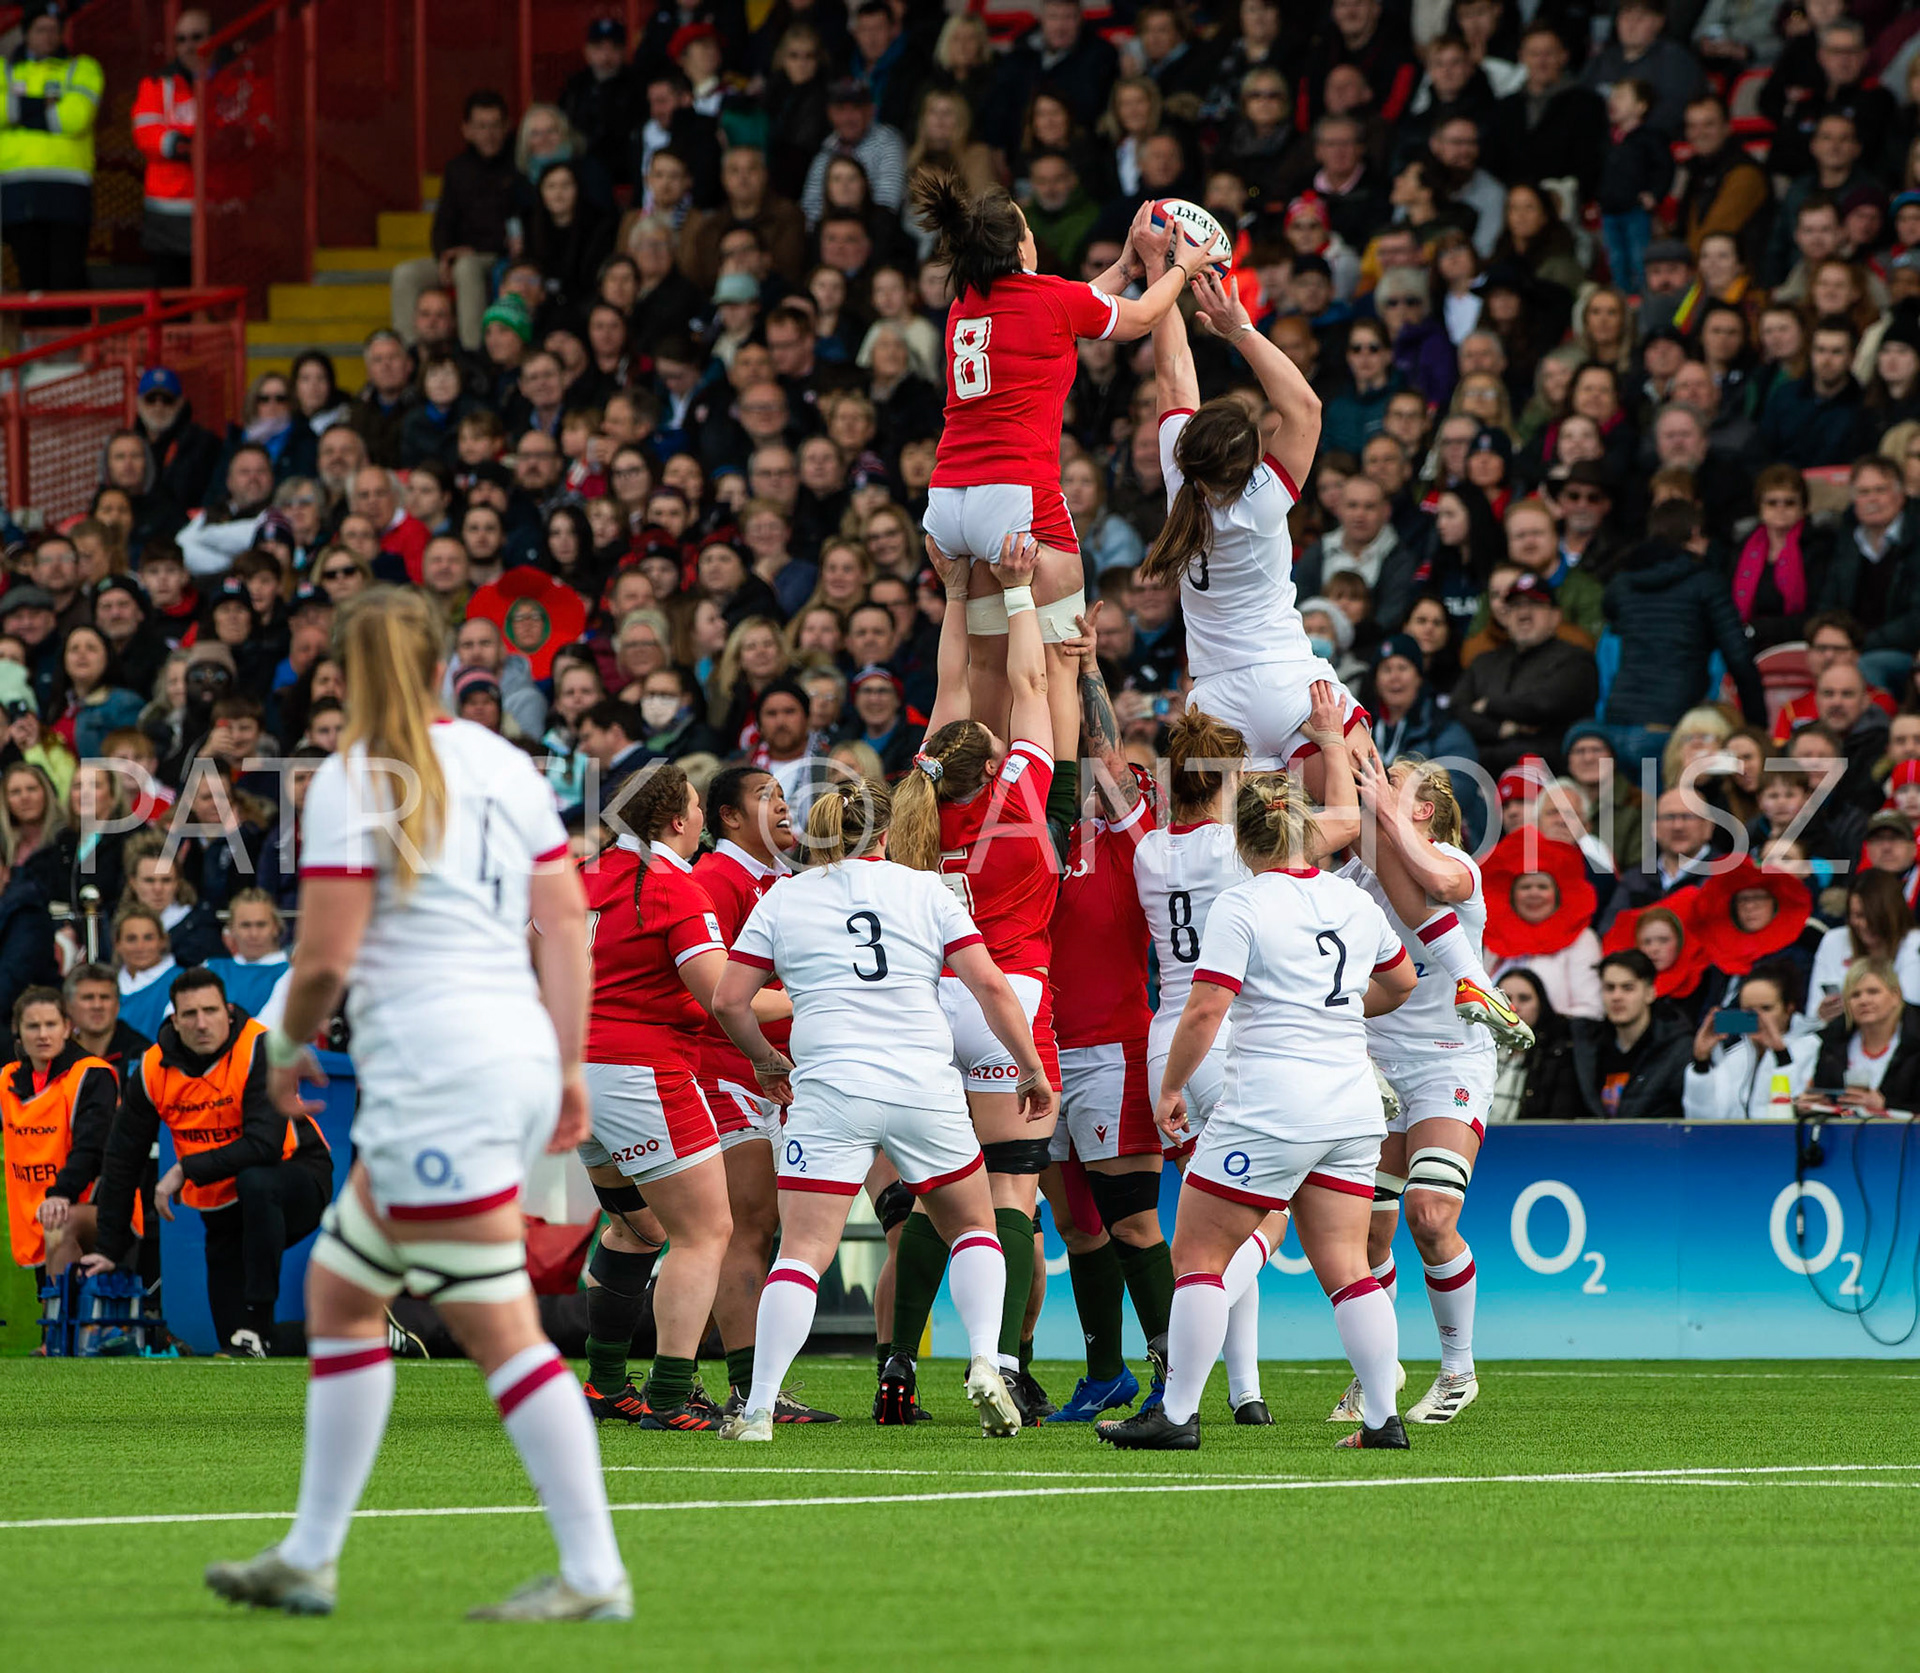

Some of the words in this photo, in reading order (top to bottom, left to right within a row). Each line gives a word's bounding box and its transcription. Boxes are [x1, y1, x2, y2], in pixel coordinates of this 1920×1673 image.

[953, 316, 992, 400] 8
[846, 911, 888, 982] 3
[1169, 891, 1200, 963] 8
[1316, 930, 1349, 1007] 2
[970, 1065, 1019, 1079] AZOO
